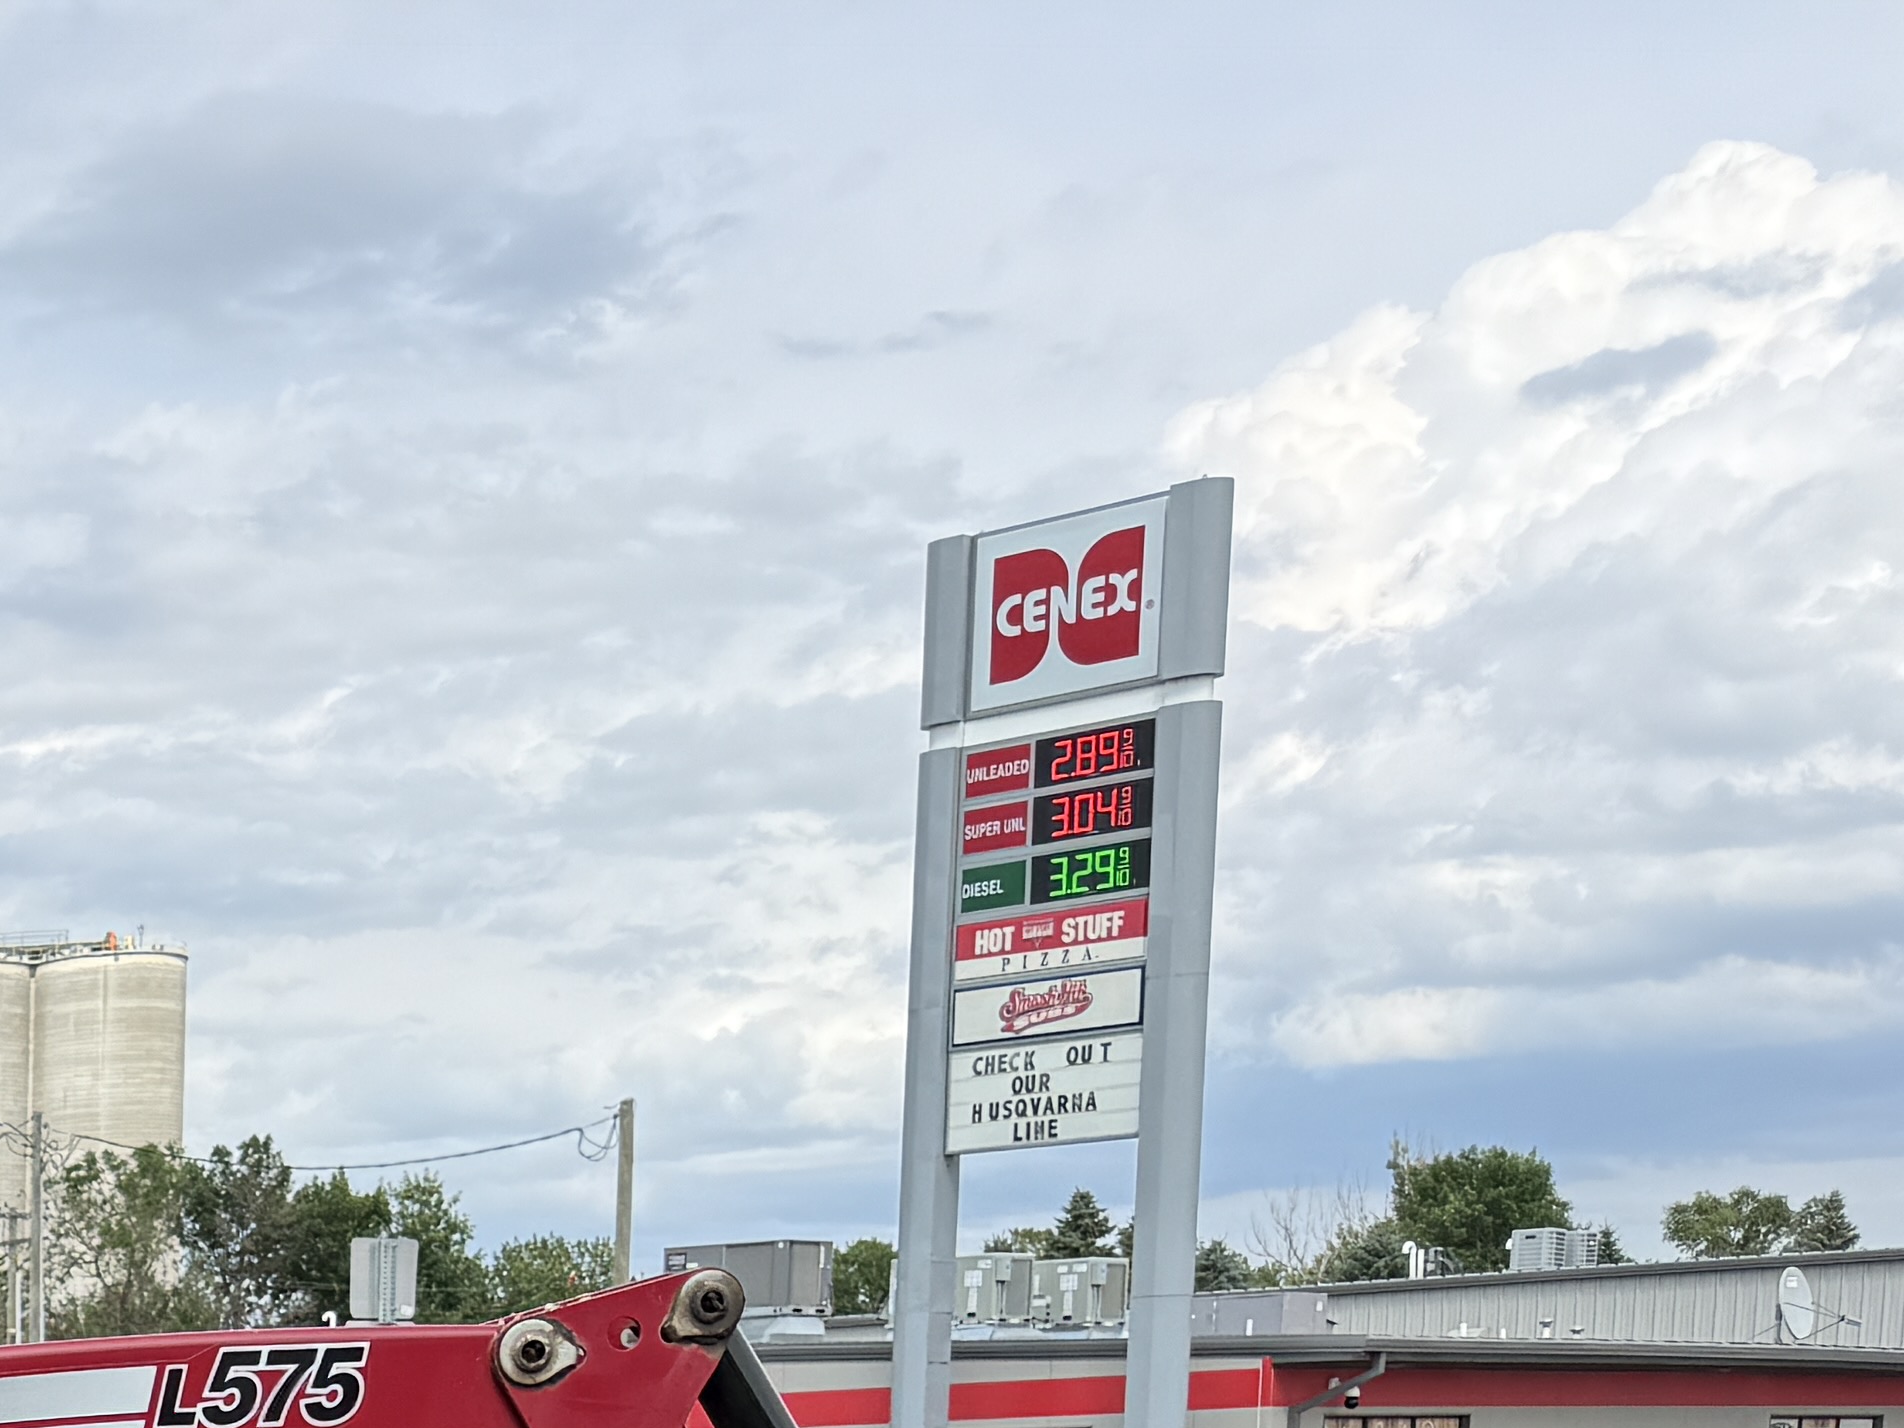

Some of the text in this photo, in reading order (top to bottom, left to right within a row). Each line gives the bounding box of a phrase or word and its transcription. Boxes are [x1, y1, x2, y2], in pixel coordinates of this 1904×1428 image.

[996, 568, 1138, 638] CENEX
[967, 759, 1030, 784] UNLEADED
[1051, 731, 1120, 781] 2.89
[964, 817, 1027, 841] SUPER UNL
[962, 879, 1004, 899] DIESEL
[1049, 849, 1115, 897] 3.29
[974, 926, 1015, 956] HOT
[1061, 910, 1125, 944] STUFF
[972, 1042, 1112, 1076] CHECK OUT
[1011, 1073, 1051, 1096] OUR
[972, 1091, 1098, 1124] HUSQVARNA
[1013, 1119, 1059, 1142] LINE
